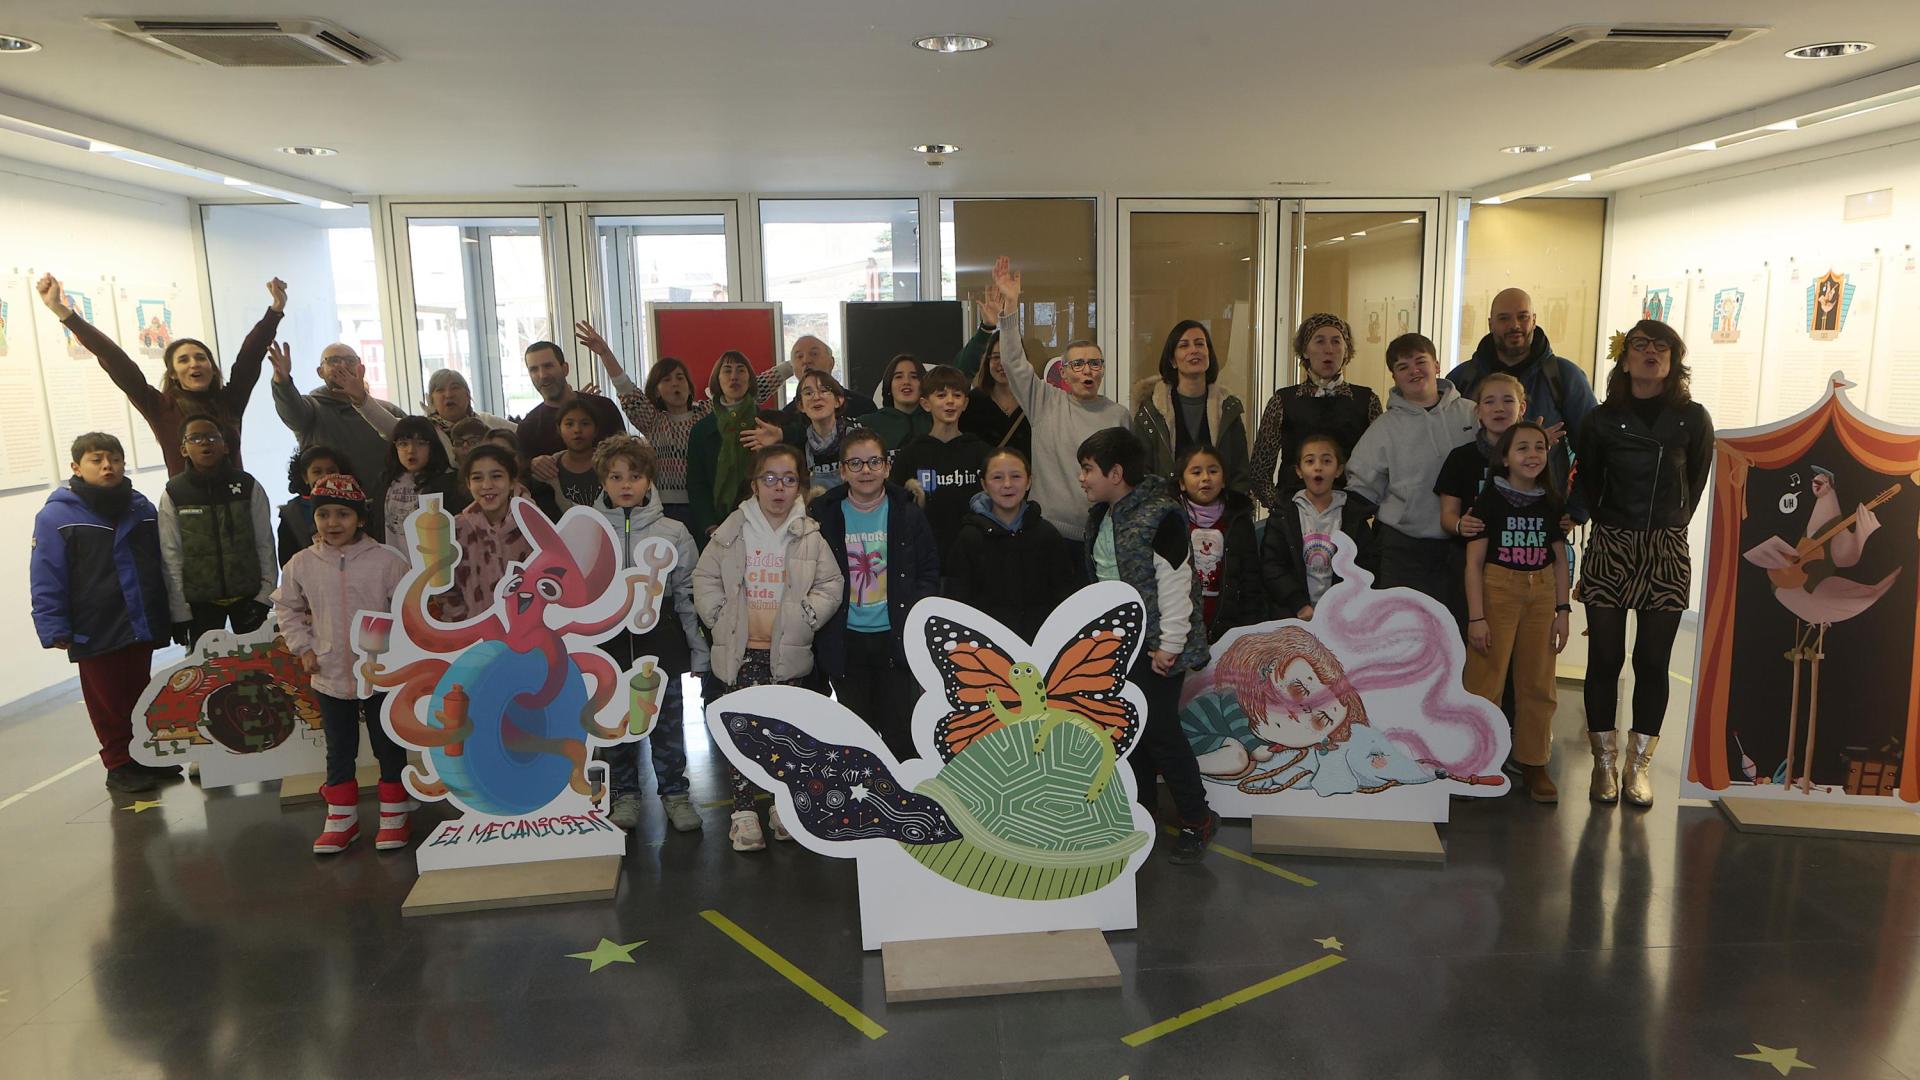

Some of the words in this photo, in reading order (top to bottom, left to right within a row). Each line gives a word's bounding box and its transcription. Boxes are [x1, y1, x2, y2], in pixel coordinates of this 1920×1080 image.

[1507, 517, 1544, 530] BRIF
[845, 531, 888, 544] PARADIS
[1501, 531, 1547, 547] BRAF
[430, 824, 464, 847] EL
